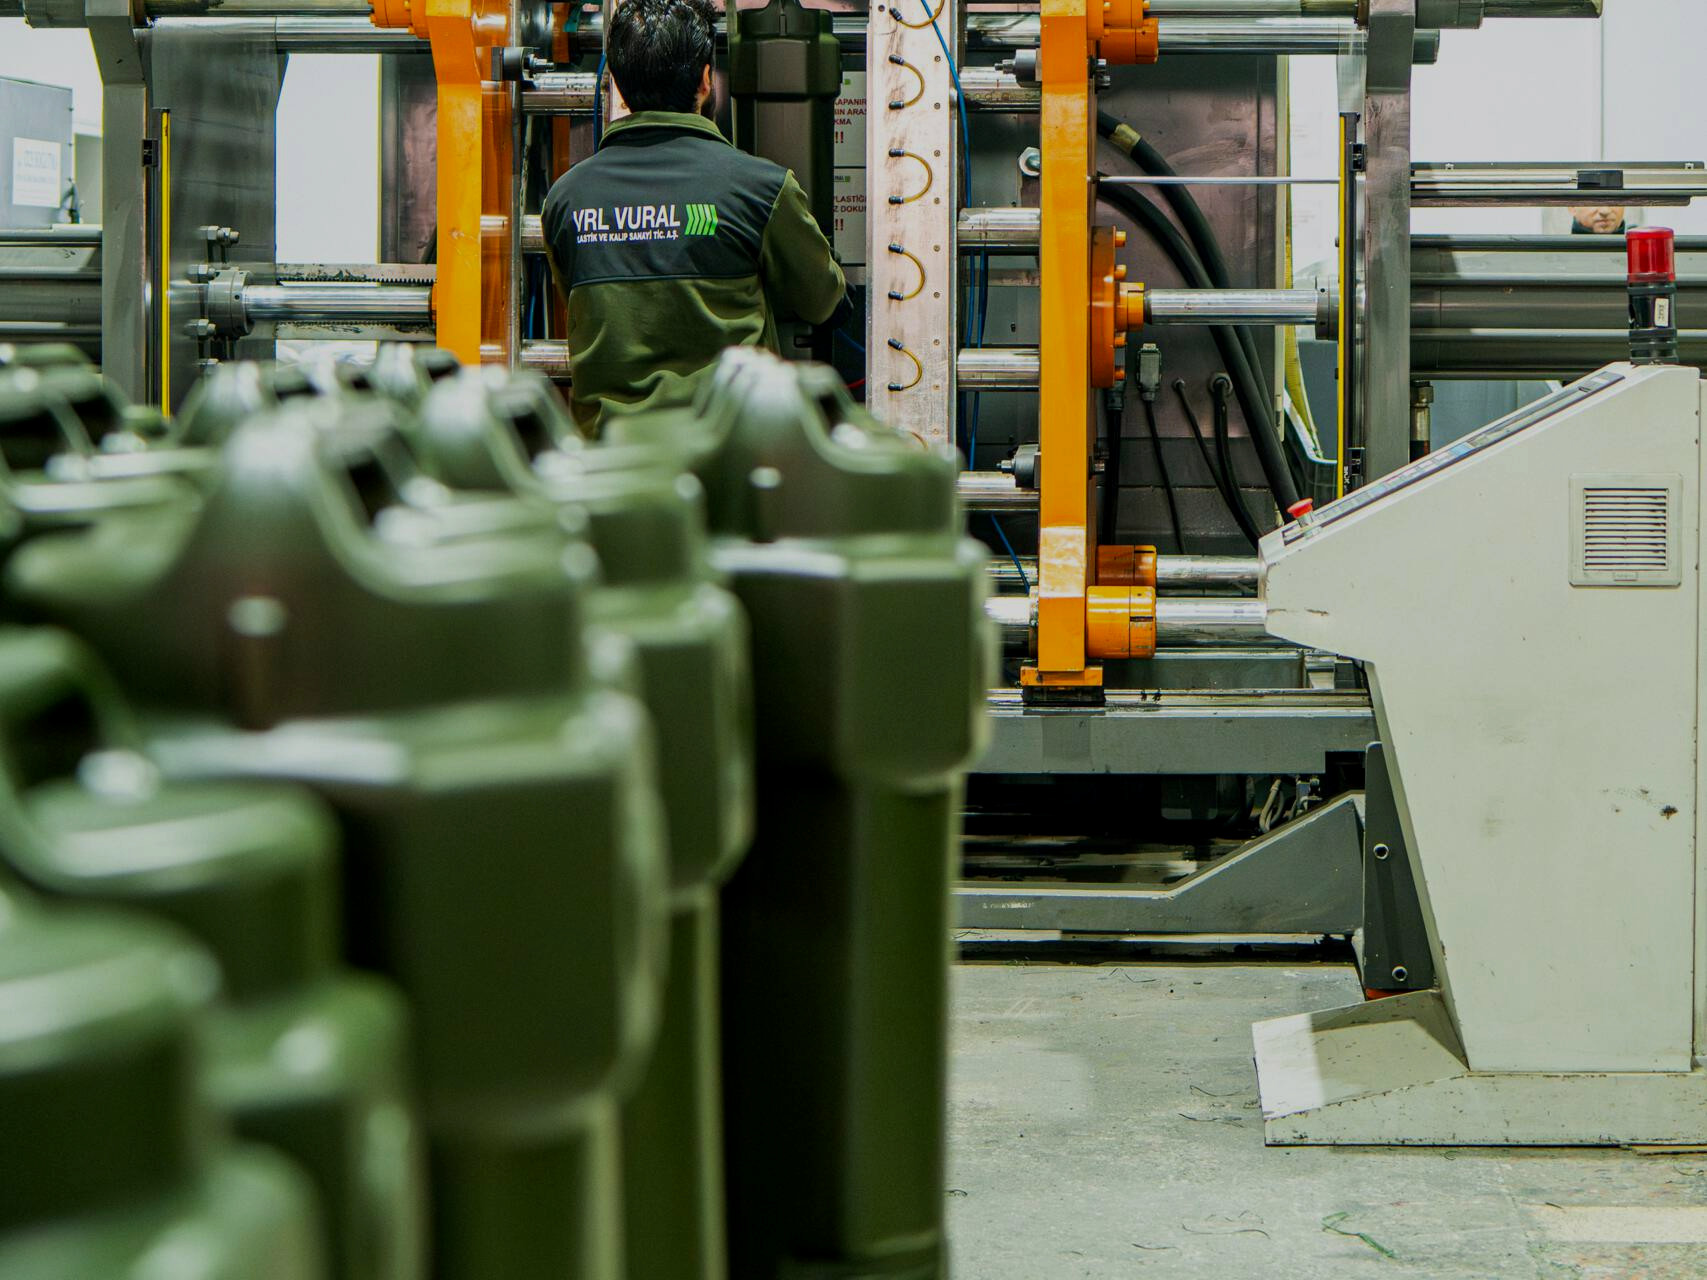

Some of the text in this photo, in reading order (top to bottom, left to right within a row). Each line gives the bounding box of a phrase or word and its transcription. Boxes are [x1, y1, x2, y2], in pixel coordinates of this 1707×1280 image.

[840, 205, 867, 213] DOKU
[573, 204, 681, 232] VRL VURAL
[599, 233, 608, 242] VE
[609, 231, 628, 242] KALIP
